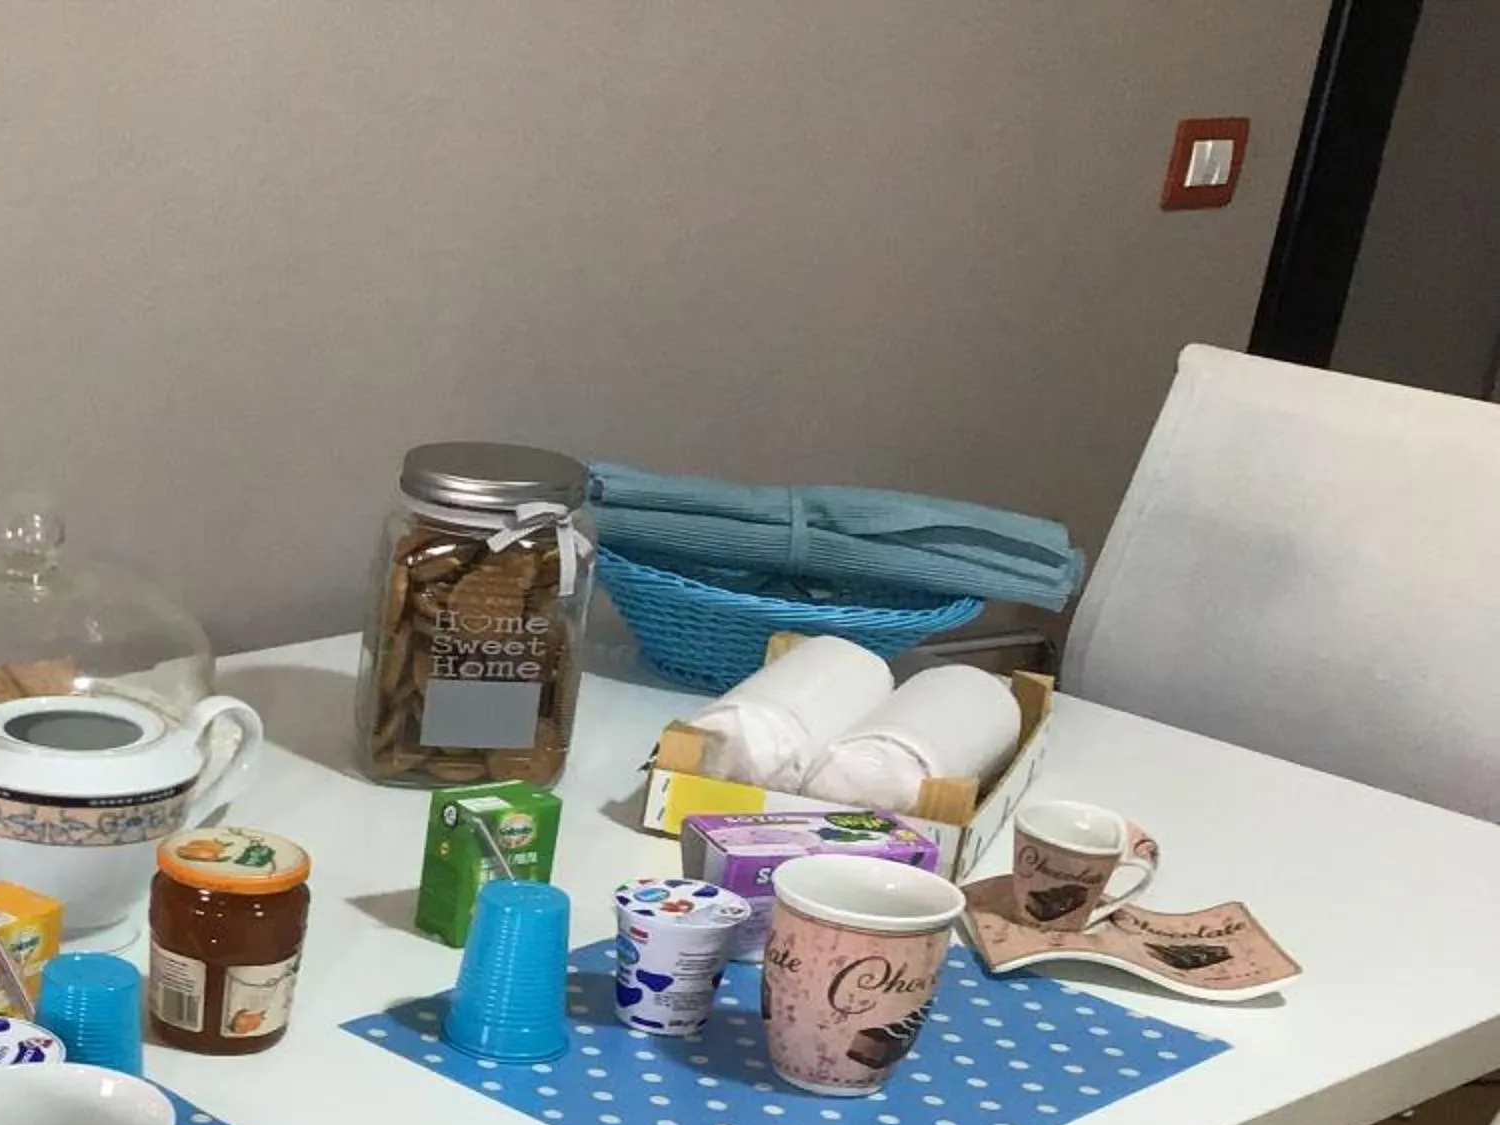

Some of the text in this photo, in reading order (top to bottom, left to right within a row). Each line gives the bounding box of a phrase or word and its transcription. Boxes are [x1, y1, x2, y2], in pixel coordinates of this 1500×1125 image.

[433, 609, 551, 635] Home
[429, 634, 547, 656] Sweet
[428, 655, 542, 679] Home
